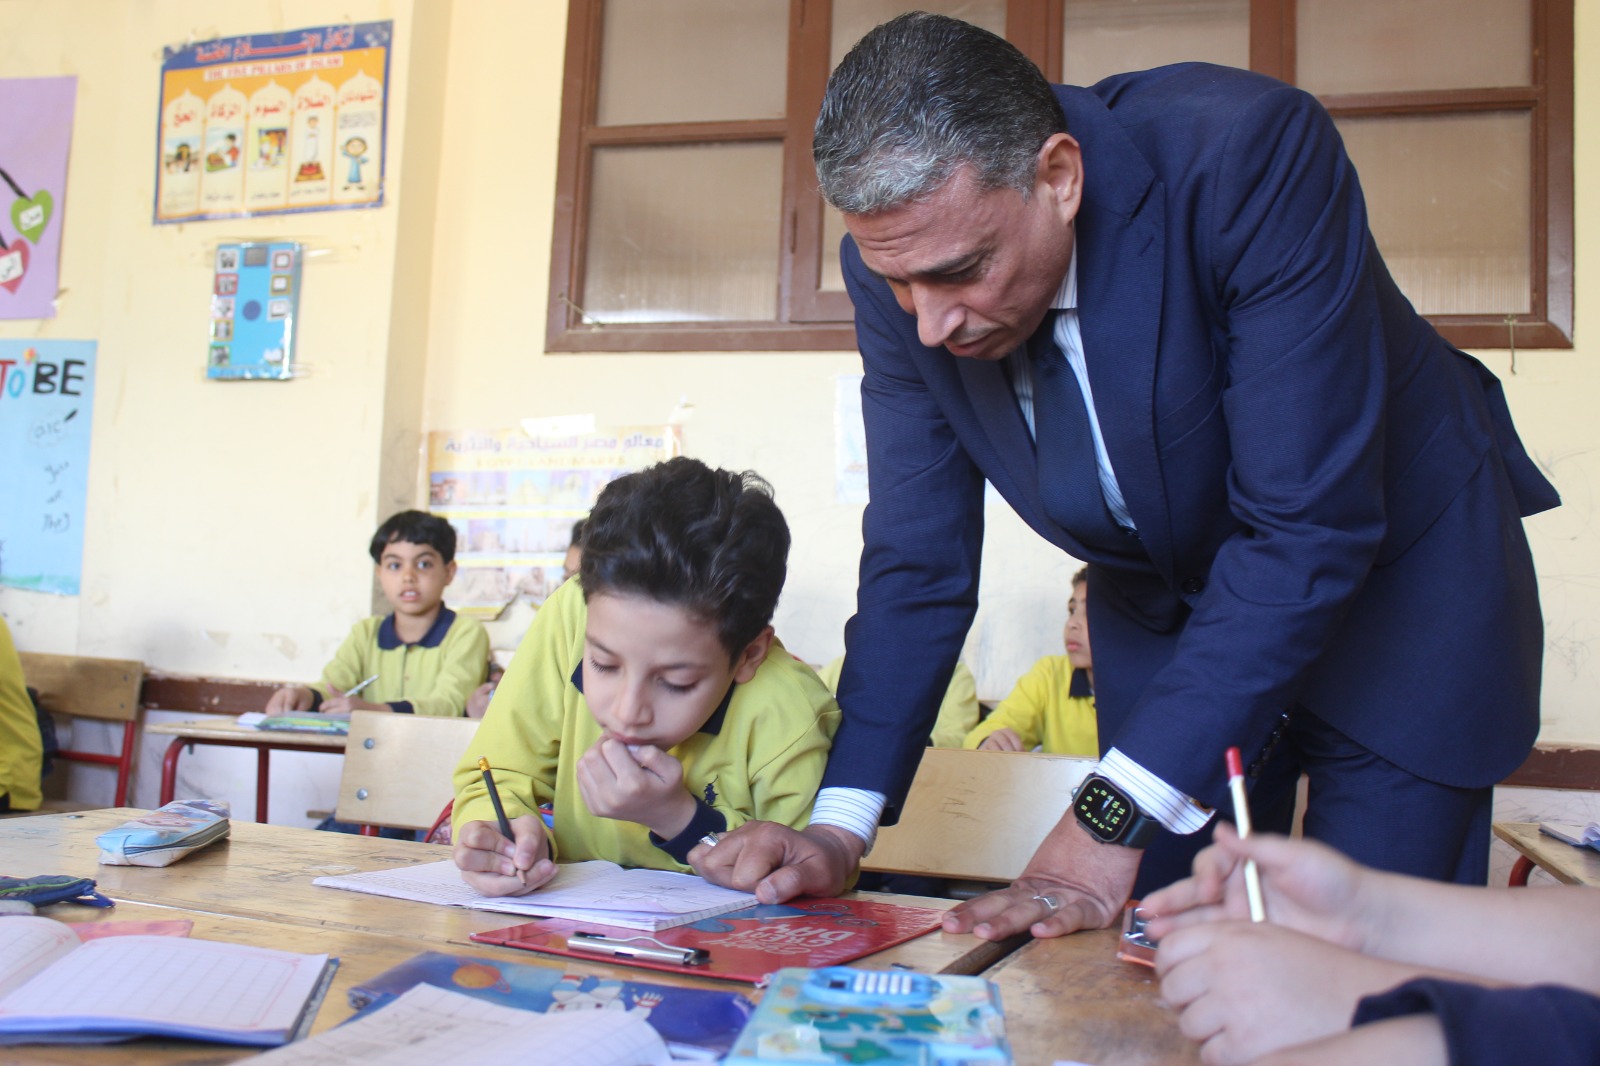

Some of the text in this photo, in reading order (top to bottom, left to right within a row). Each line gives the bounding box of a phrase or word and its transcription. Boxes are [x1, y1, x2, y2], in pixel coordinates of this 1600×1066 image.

[207, 56, 341, 80] THE FIVE PILLARS OF ISLAM
[33, 359, 86, 396] BE
[582, 437, 618, 452] مصر
[730, 929, 835, 947] GREAT
[756, 923, 857, 941] DAY
